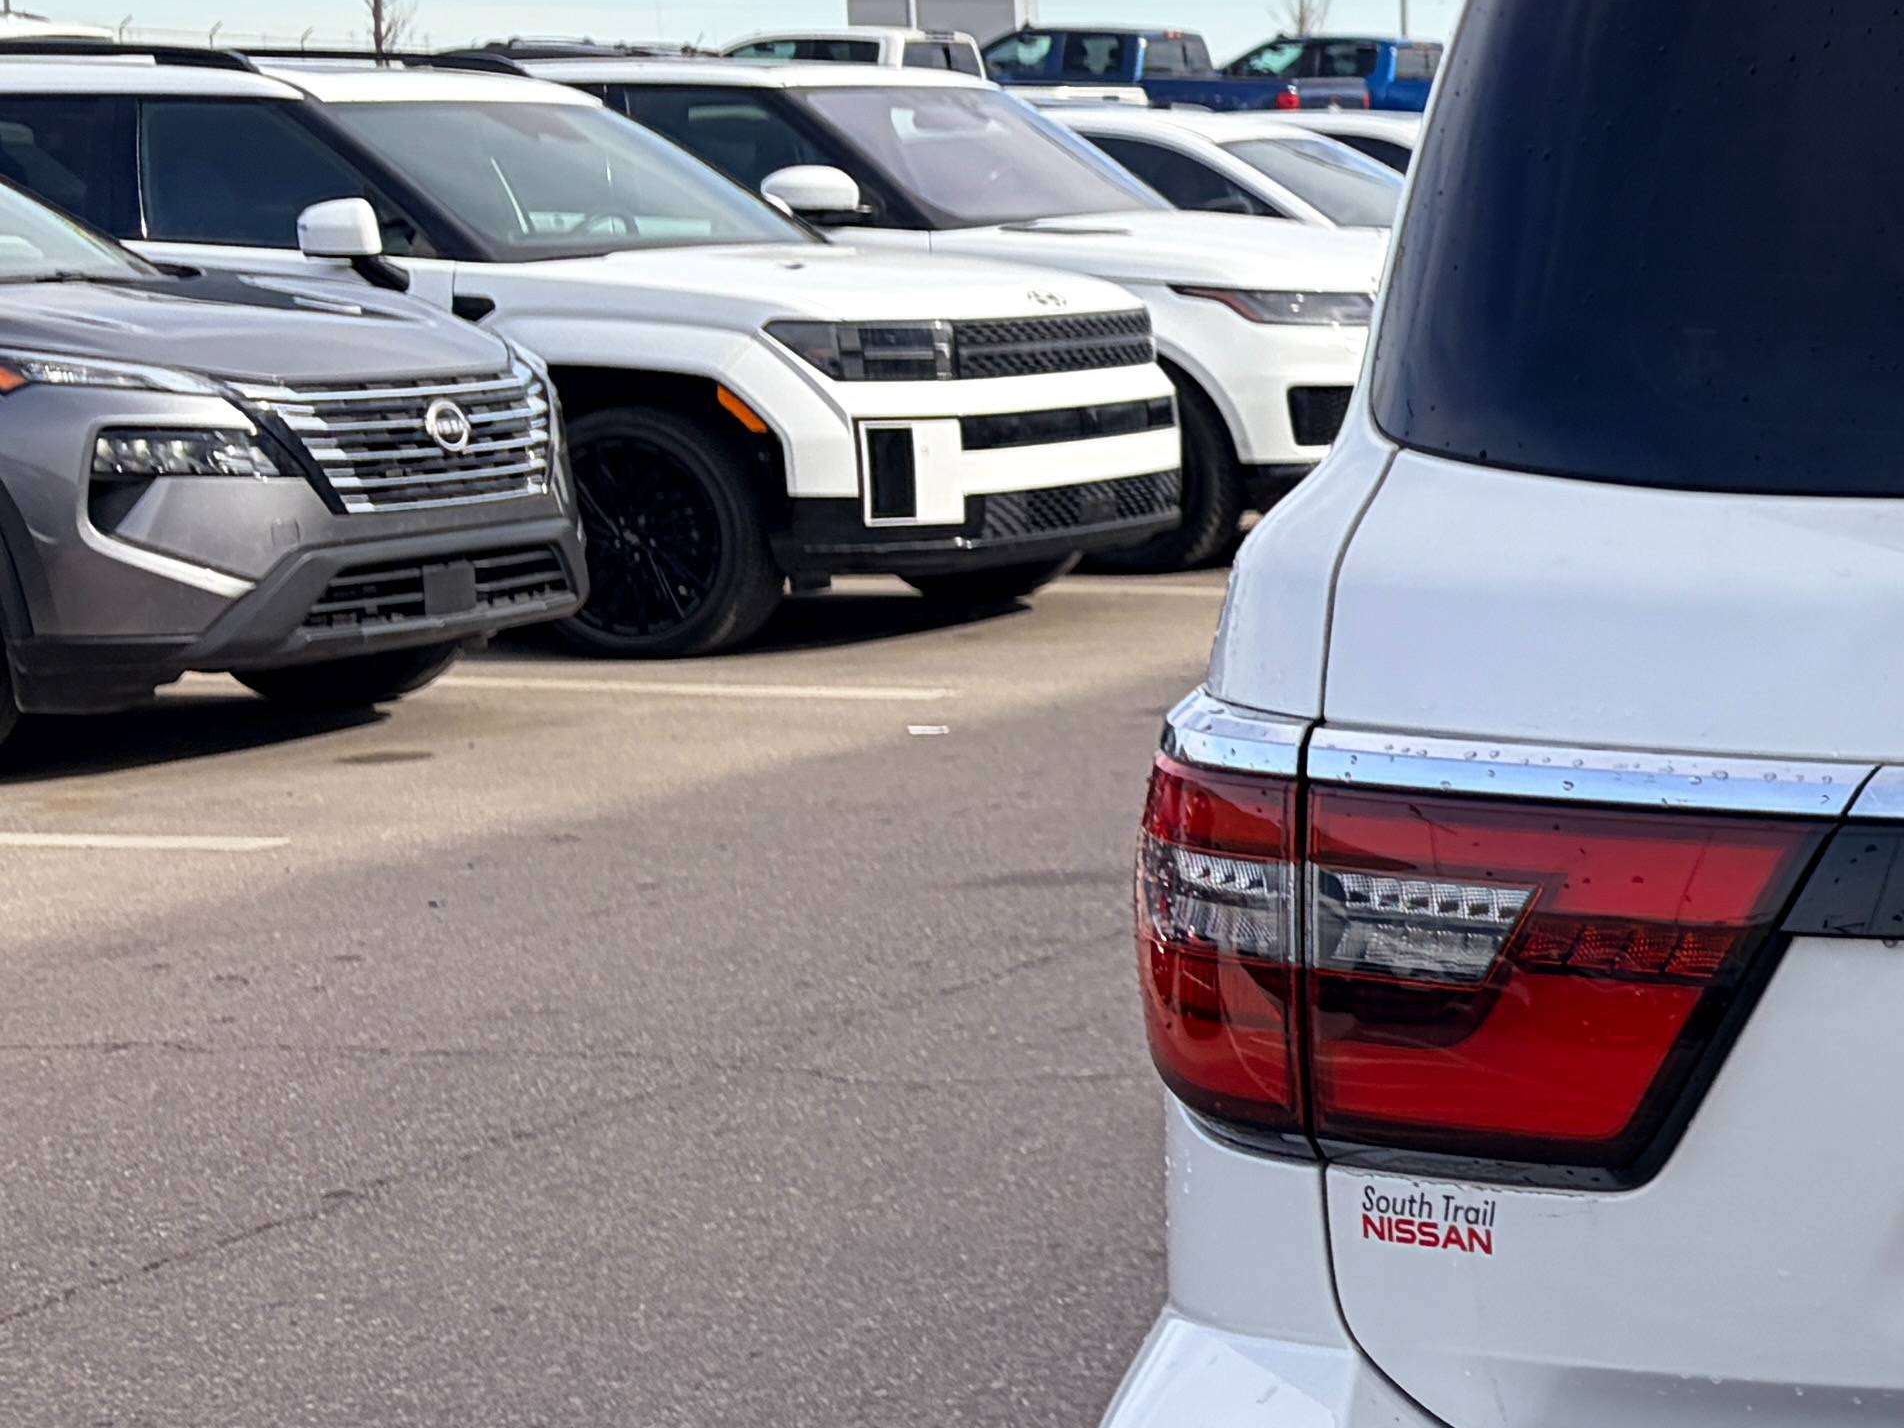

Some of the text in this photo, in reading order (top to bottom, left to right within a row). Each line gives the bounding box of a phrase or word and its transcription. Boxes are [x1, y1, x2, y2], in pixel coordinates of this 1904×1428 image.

[1362, 1184, 1496, 1227] South Trail
[1362, 1212, 1493, 1256] NISSAN
